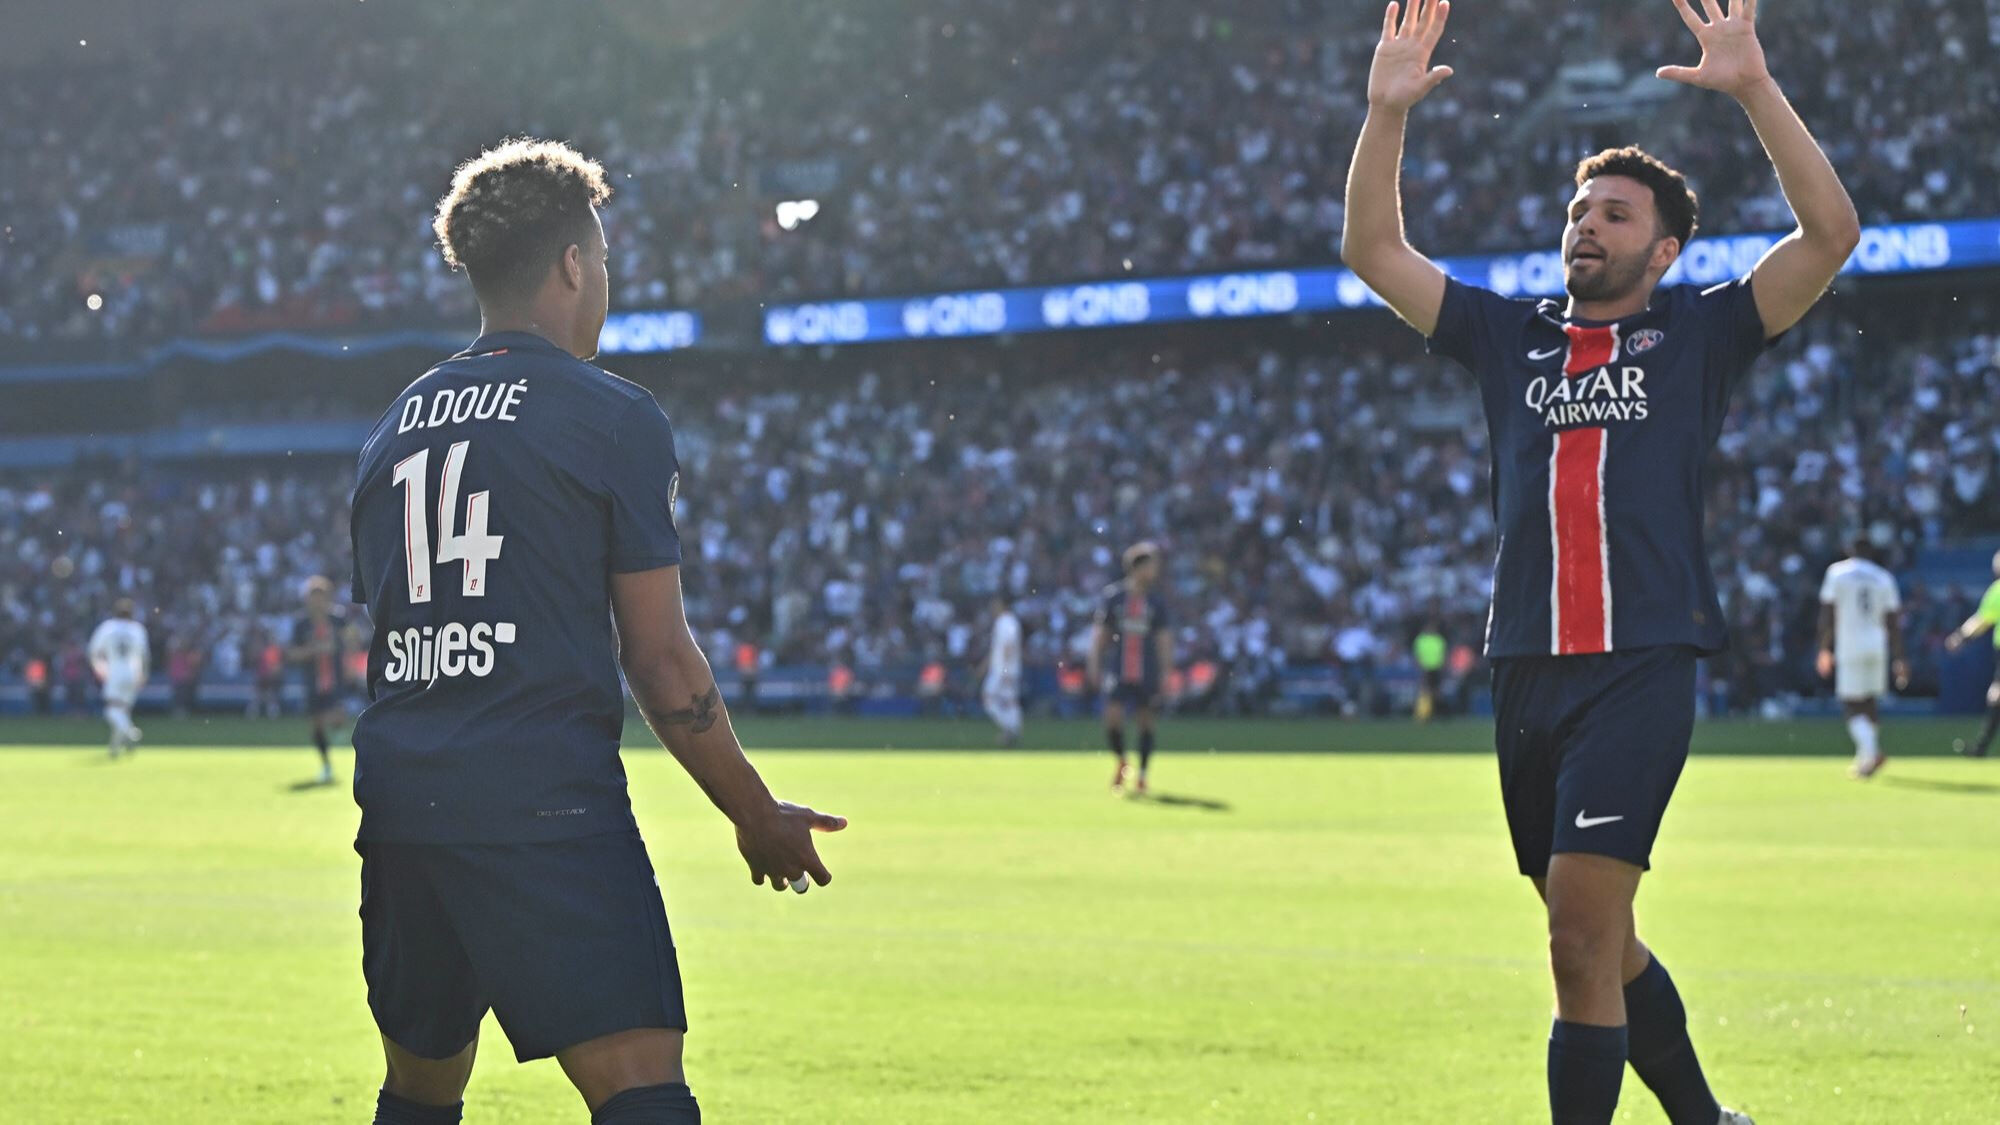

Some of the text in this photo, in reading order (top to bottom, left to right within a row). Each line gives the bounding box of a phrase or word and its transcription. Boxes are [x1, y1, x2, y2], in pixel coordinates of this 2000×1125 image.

[1858, 223, 1950, 273] QNB
[931, 293, 1006, 334] QNB
[1072, 283, 1150, 325] QNB
[1217, 272, 1298, 315] QNB
[796, 302, 868, 343] QNB
[398, 378, 528, 435] D.DOUÉ
[1525, 366, 1648, 414] QATAR
[1544, 400, 1648, 427] AIRWAYS
[392, 440, 503, 604] 14
